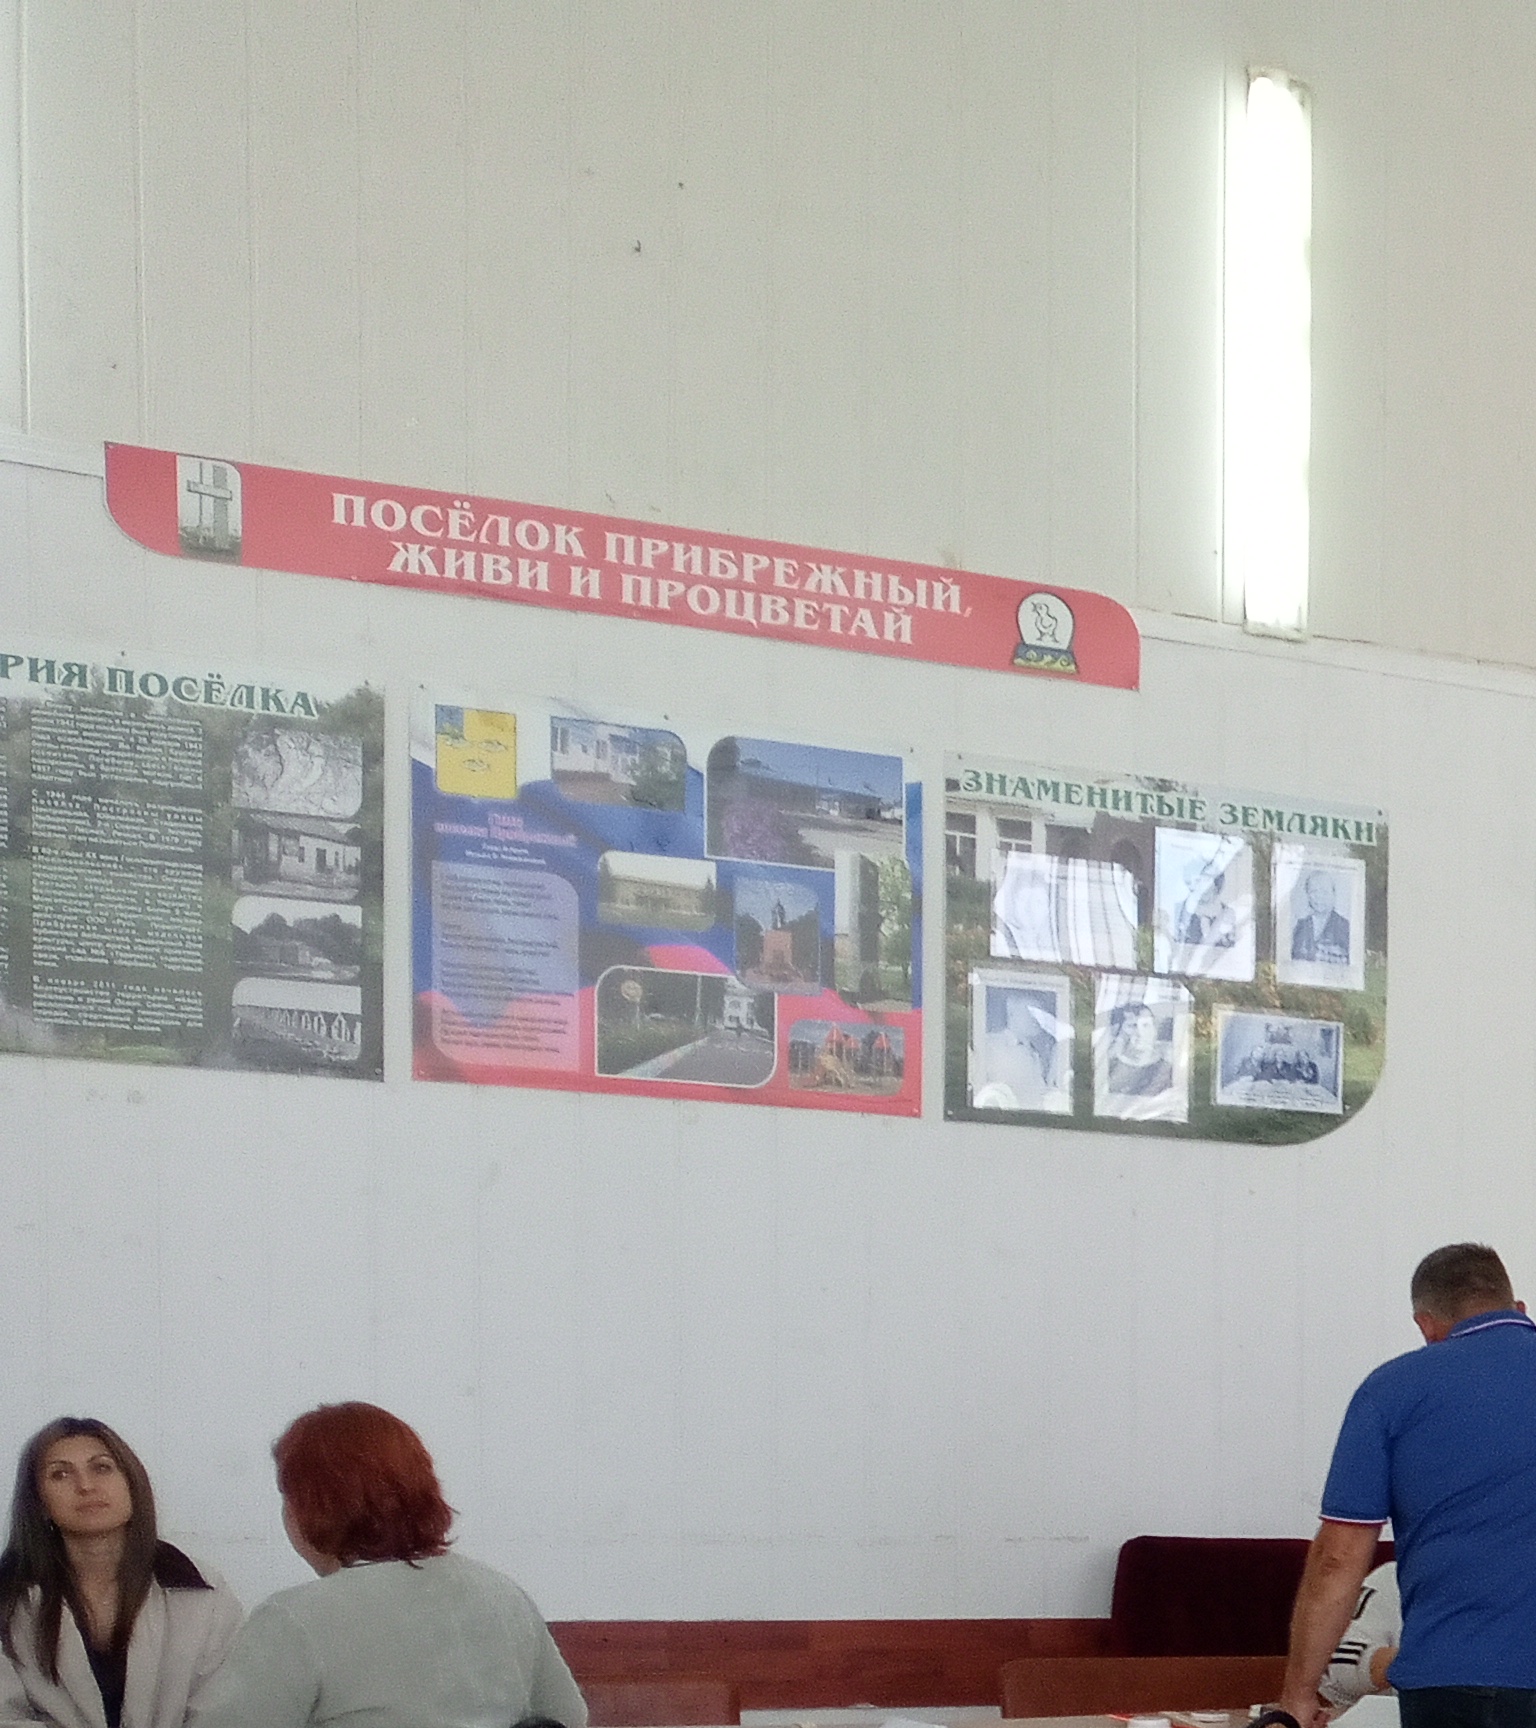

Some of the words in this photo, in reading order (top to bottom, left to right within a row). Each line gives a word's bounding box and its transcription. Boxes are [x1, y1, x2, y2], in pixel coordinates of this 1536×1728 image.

[331, 492, 586, 558] ПОСЁЛОК
[604, 531, 972, 617] ПРИБРЕЖНЫЙ,
[387, 541, 551, 592] ЖИВИ
[569, 566, 602, 599] И
[621, 573, 914, 644] ПРОЦВЕТАЙ
[106, 666, 317, 718] ПОСЁЛКА
[962, 768, 1207, 821] ЗНАМЕНИТЫЕ
[1219, 802, 1376, 844] ЗЕМЛЯКИ
